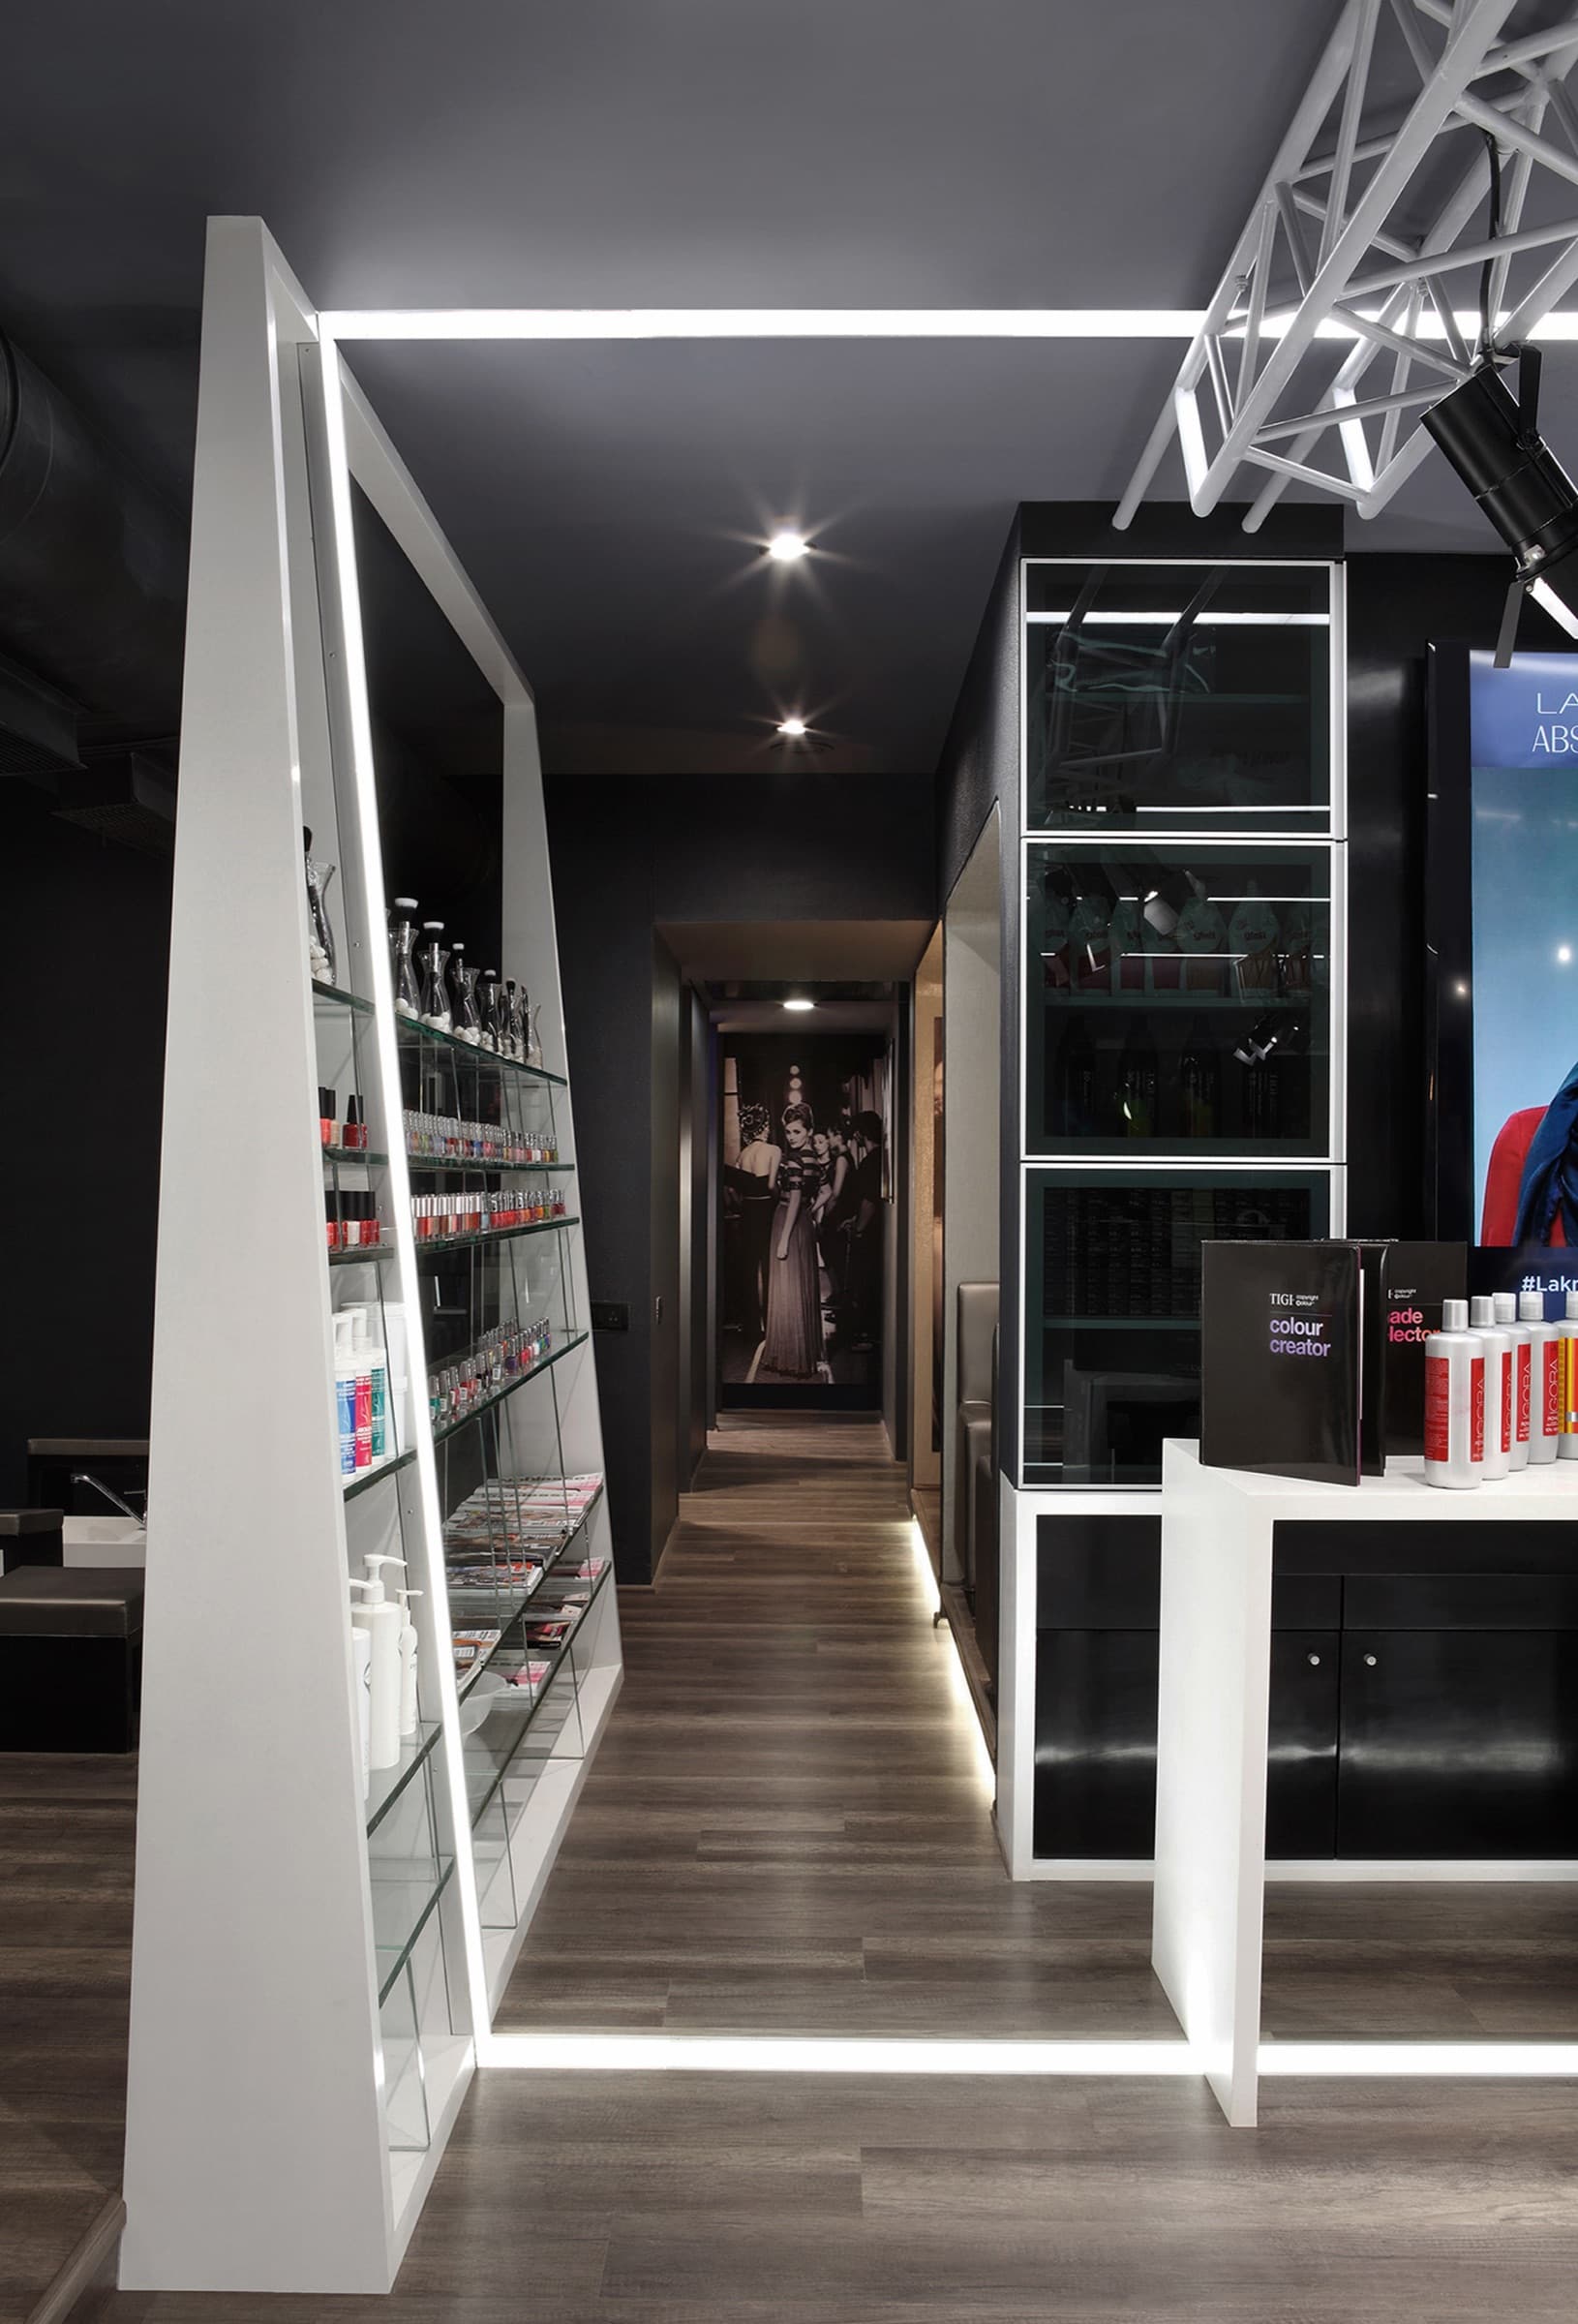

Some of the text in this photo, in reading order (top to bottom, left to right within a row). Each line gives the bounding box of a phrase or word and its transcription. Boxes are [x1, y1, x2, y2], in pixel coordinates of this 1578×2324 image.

[1269, 1293, 1294, 1306] TIGI
[1388, 1307, 1423, 1324] ade
[1269, 1317, 1323, 1336] colour
[1269, 1338, 1332, 1357] creator
